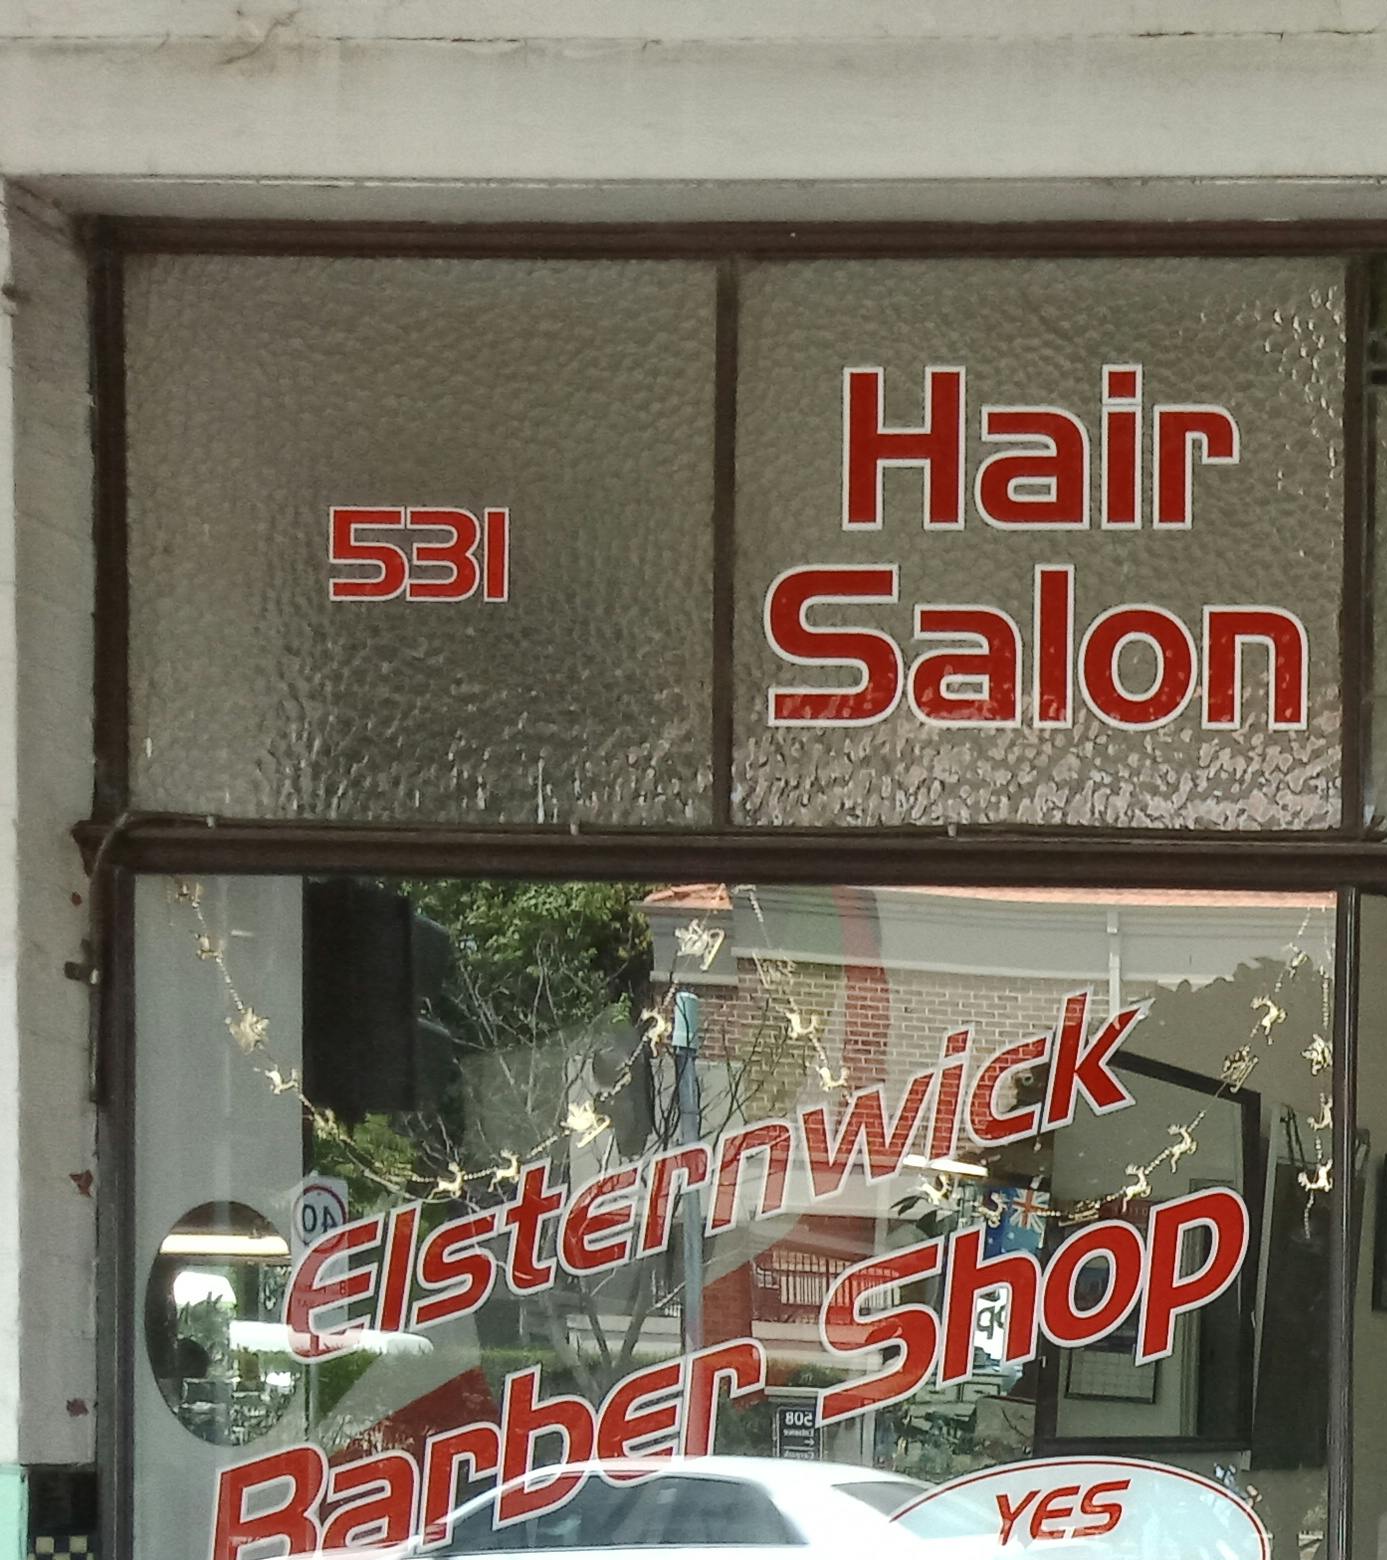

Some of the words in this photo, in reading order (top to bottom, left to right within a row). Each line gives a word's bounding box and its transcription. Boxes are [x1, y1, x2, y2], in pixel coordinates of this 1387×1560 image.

[841, 363, 1241, 531] Hair
[327, 505, 511, 603] 531
[763, 563, 1309, 731] Salon
[285, 986, 1152, 1364] Elsternwick
[815, 1188, 1250, 1429] Shop
[995, 1479, 1132, 1546] YES
